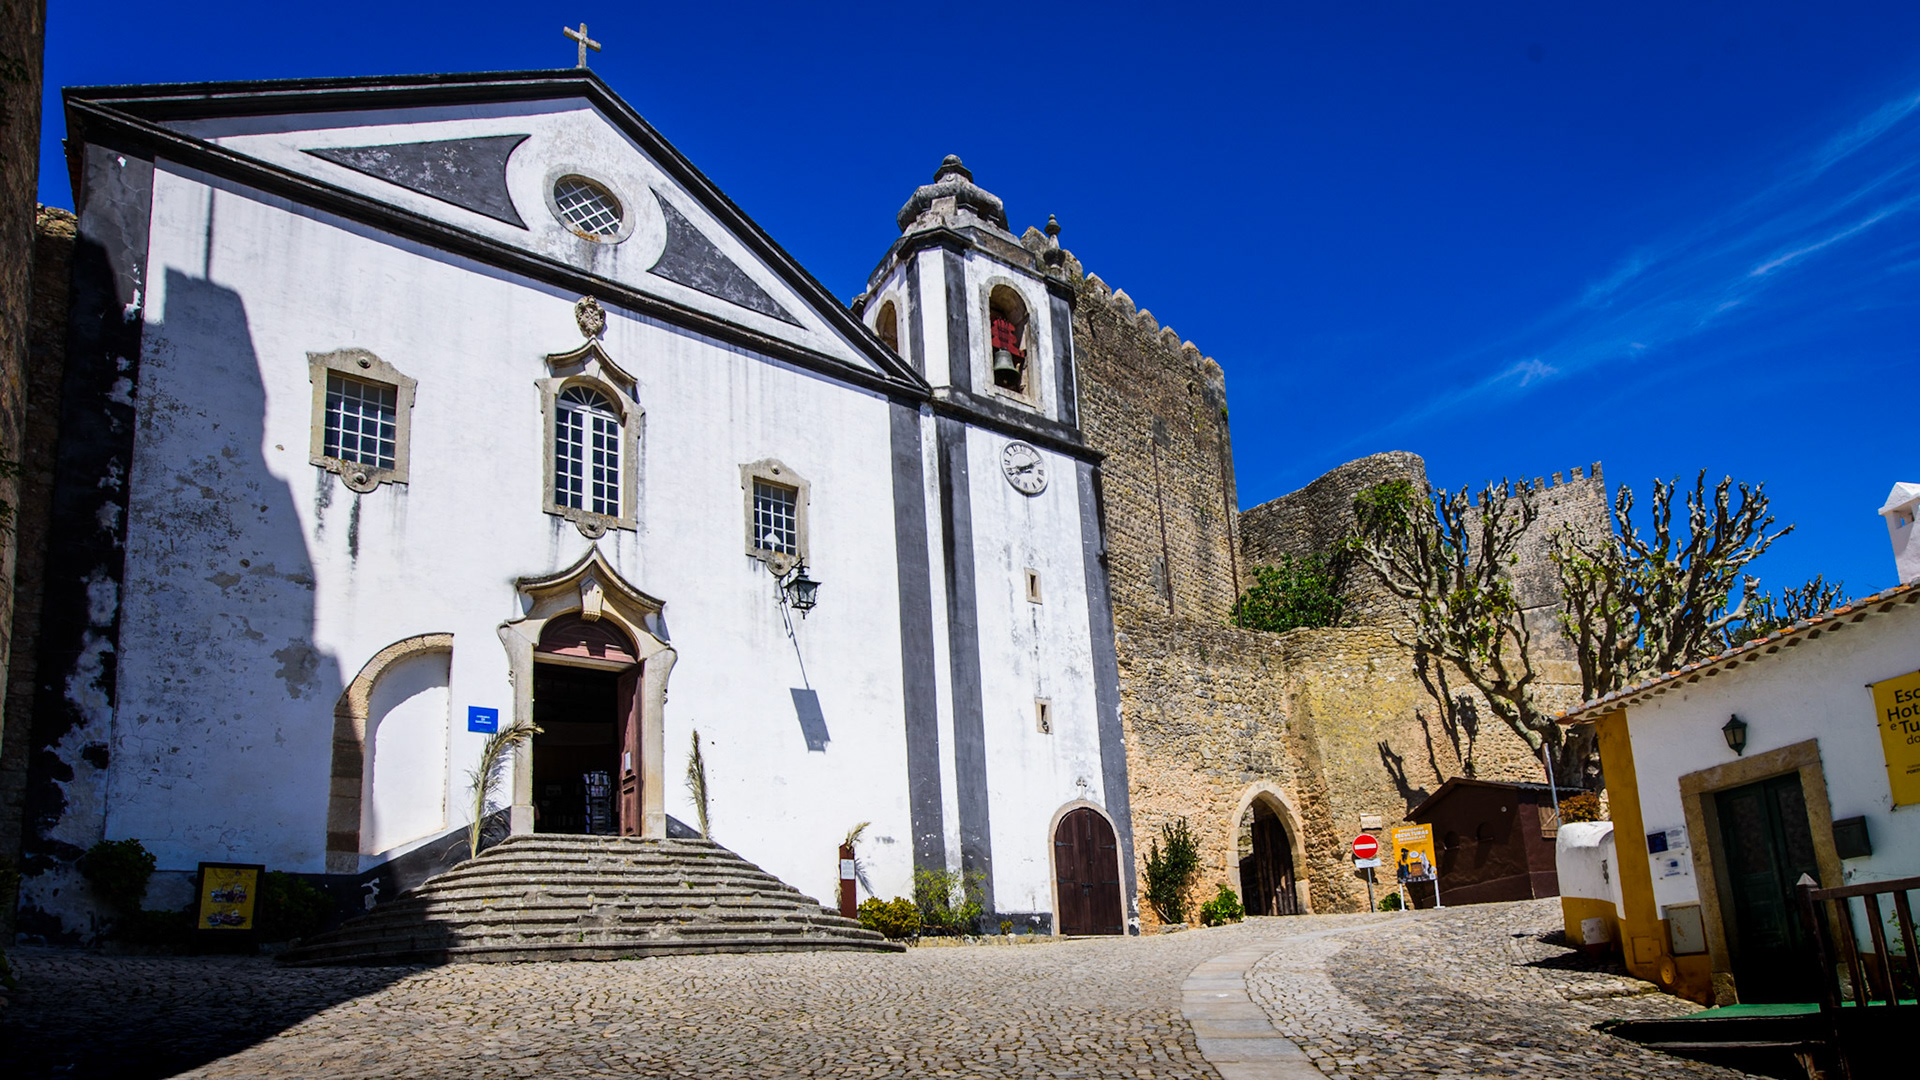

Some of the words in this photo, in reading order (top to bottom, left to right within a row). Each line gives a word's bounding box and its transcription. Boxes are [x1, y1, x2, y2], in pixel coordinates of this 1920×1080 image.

[1894, 688, 1920, 704] Esc
[1887, 703, 1920, 721] Hot
[1890, 722, 1897, 731] e
[1899, 720, 1920, 734] Tu
[1906, 734, 1920, 745] do
